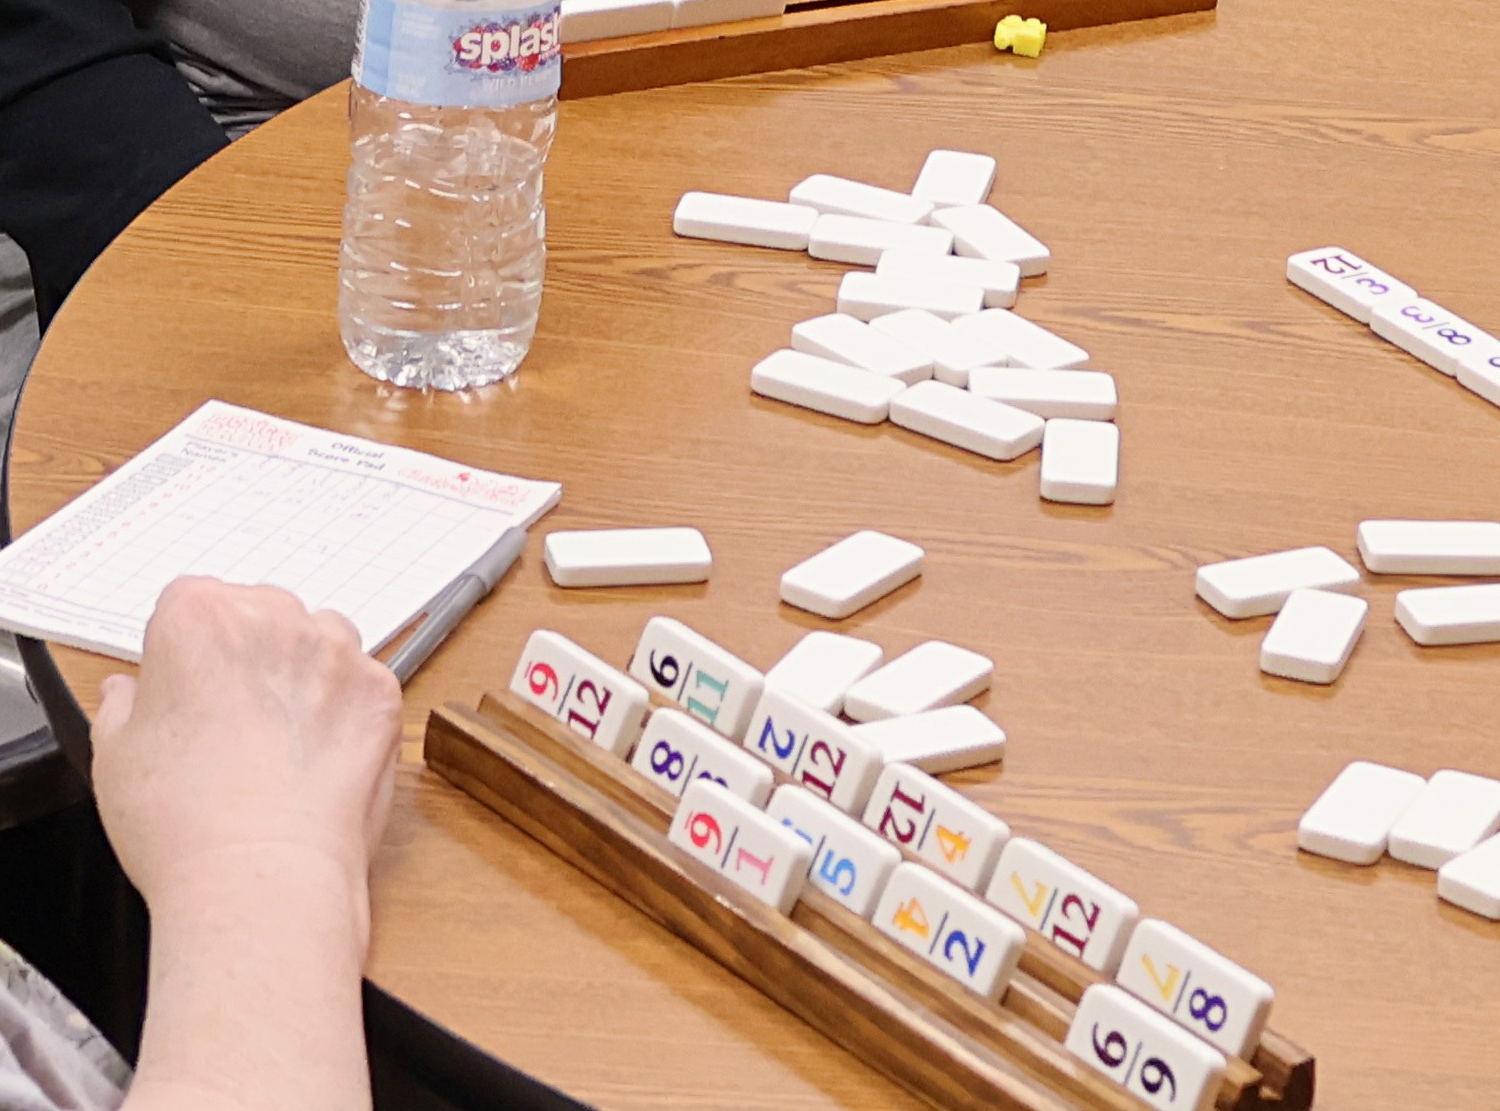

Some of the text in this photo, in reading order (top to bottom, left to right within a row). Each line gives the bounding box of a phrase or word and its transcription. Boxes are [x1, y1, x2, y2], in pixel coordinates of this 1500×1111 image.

[1310, 254, 1390, 296] 12 3
[1401, 305, 1472, 346] 3 8
[567, 679, 613, 740] 12
[687, 669, 729, 727] 11
[650, 740, 684, 782] 8
[758, 715, 847, 801] 2 12
[879, 781, 973, 865] 12 4
[736, 848, 774, 886] 1
[819, 849, 856, 897] 5
[892, 897, 986, 977] 4 2
[1010, 872, 1100, 958] 7 12
[1141, 953, 1227, 1032] 7 8
